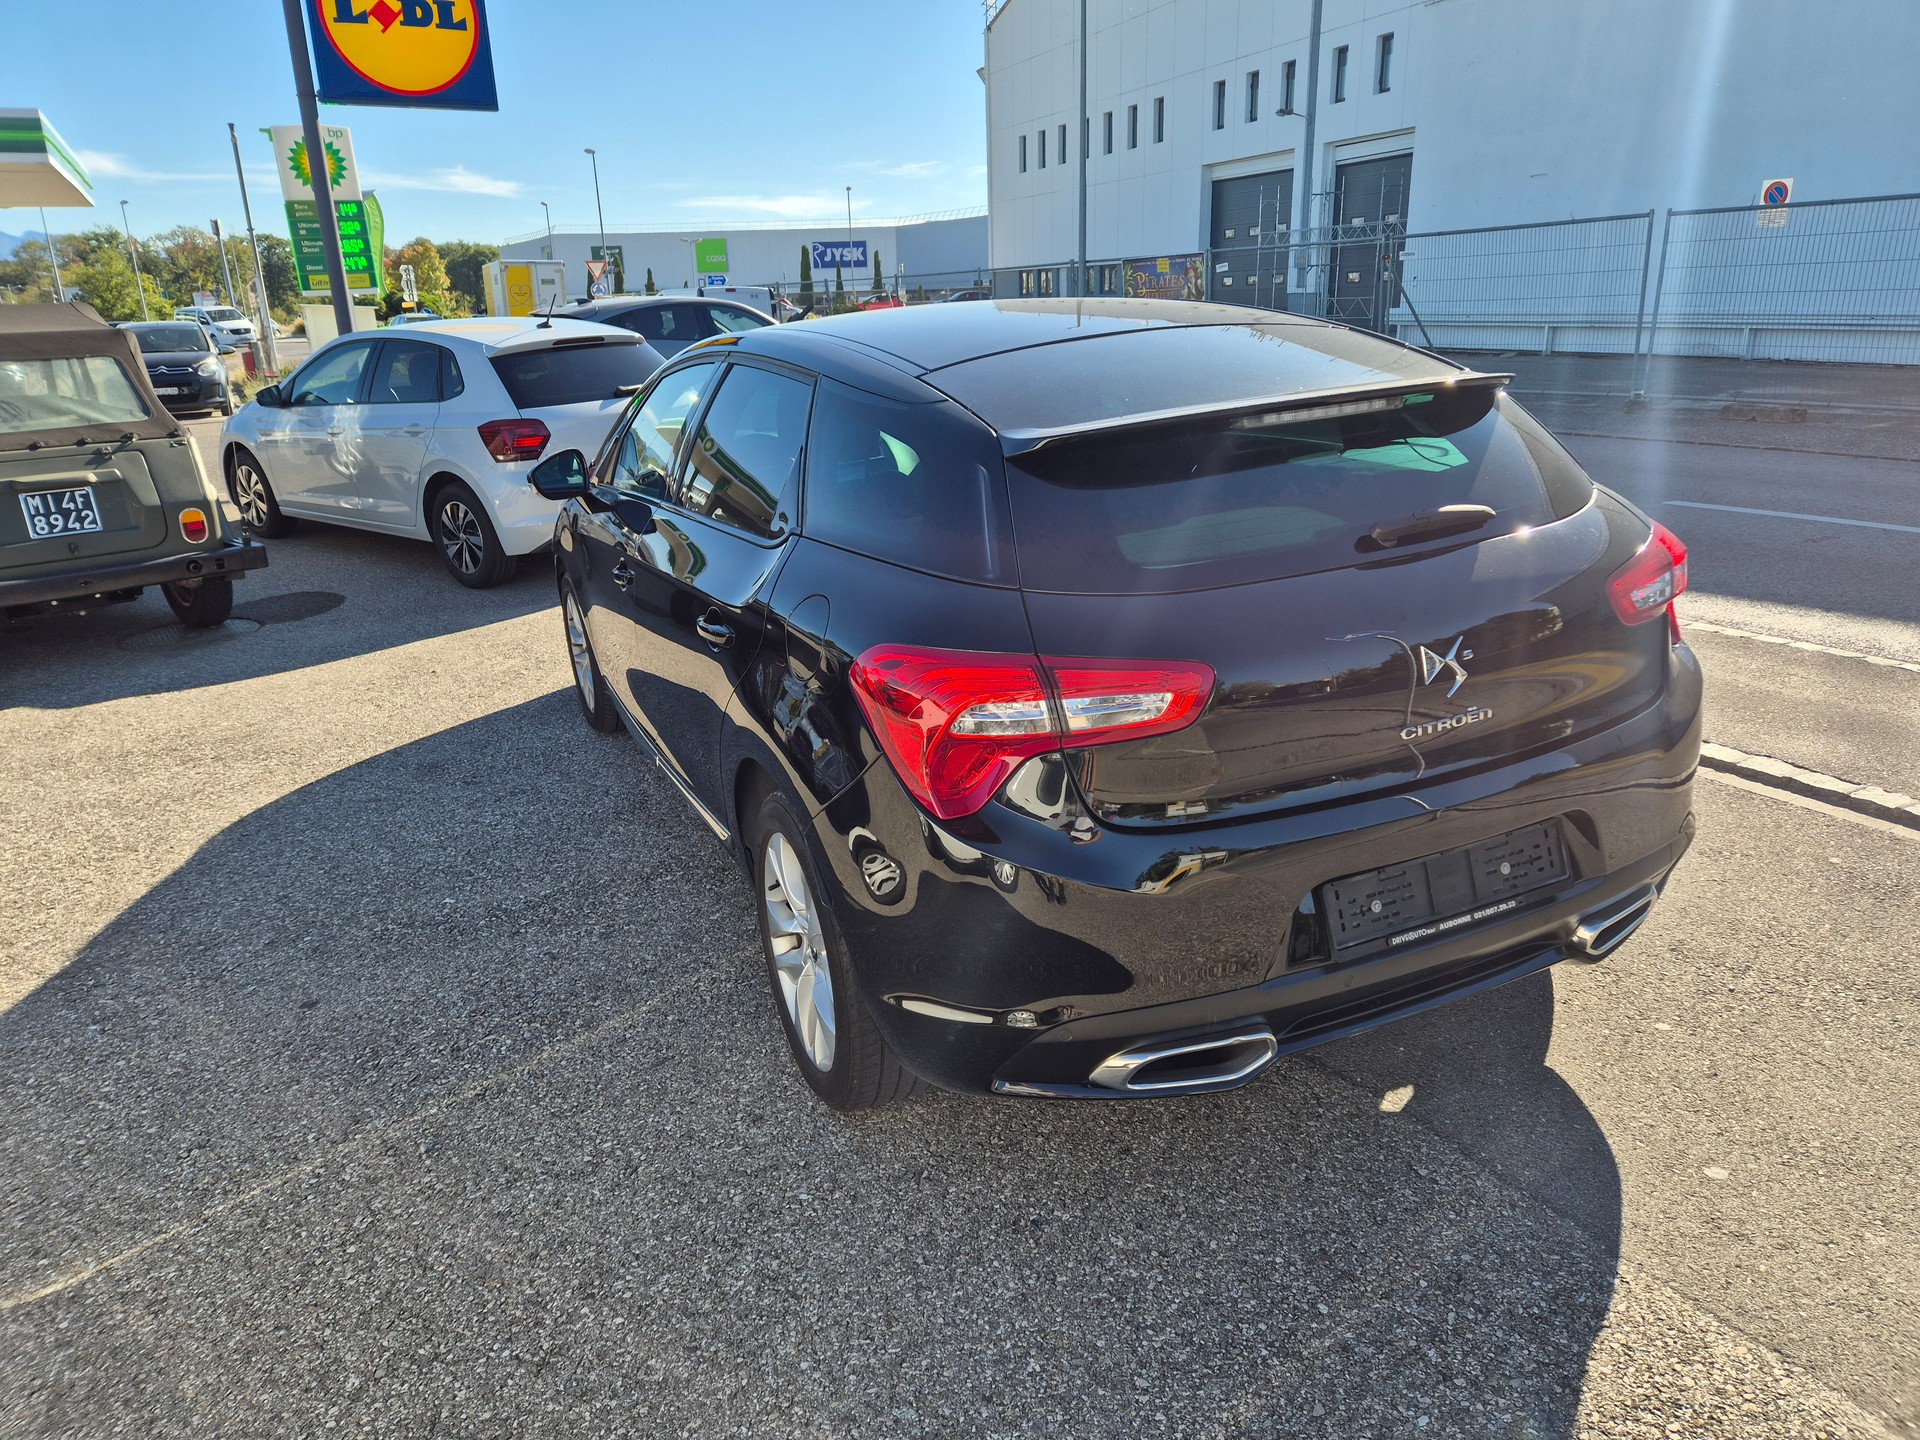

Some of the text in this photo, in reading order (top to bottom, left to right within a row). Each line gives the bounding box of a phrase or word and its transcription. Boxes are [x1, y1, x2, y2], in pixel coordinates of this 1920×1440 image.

[327, 127, 343, 140] bp
[824, 247, 865, 262] JYSK
[34, 510, 97, 534] 8942
[1439, 915, 1472, 930] AUBONNE
